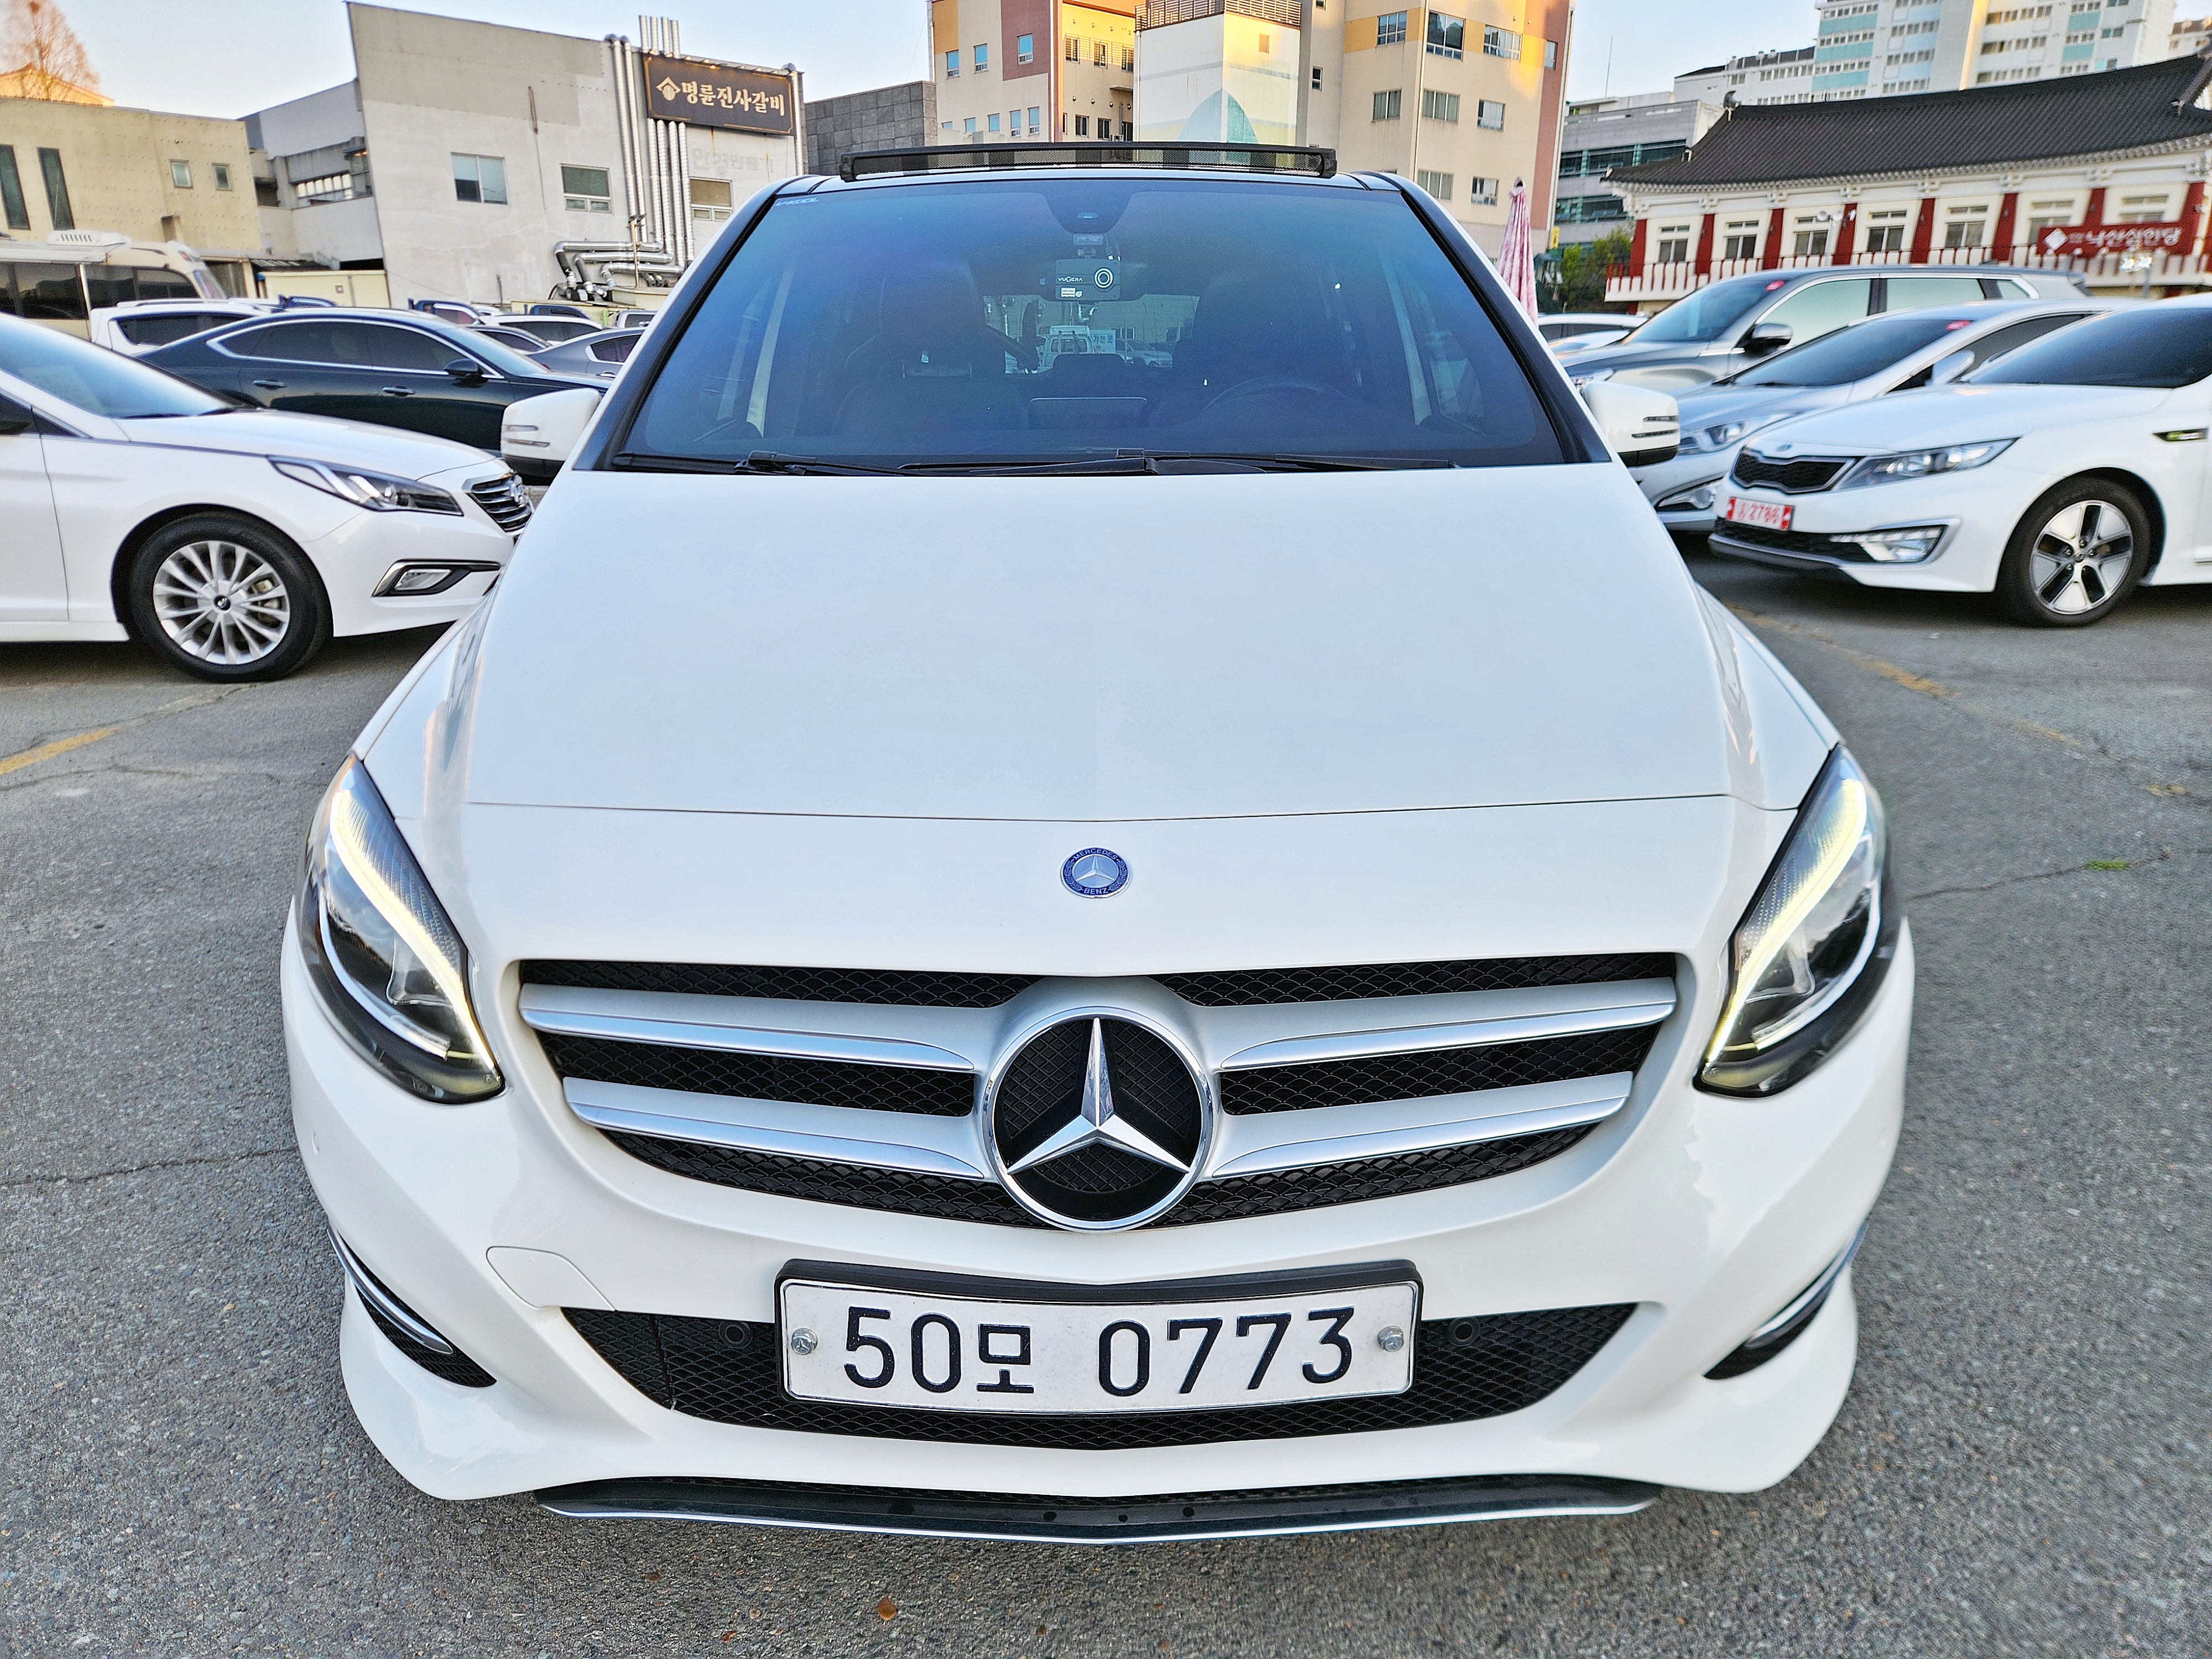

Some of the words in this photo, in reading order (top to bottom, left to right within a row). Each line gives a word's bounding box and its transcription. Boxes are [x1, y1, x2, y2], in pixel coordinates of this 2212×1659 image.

[681, 81, 785, 116] 명륜진사갈비
[1073, 848, 1118, 860] MERCEDES
[843, 1305, 1035, 1395] 50모
[1098, 1306, 1356, 1397] 0773
